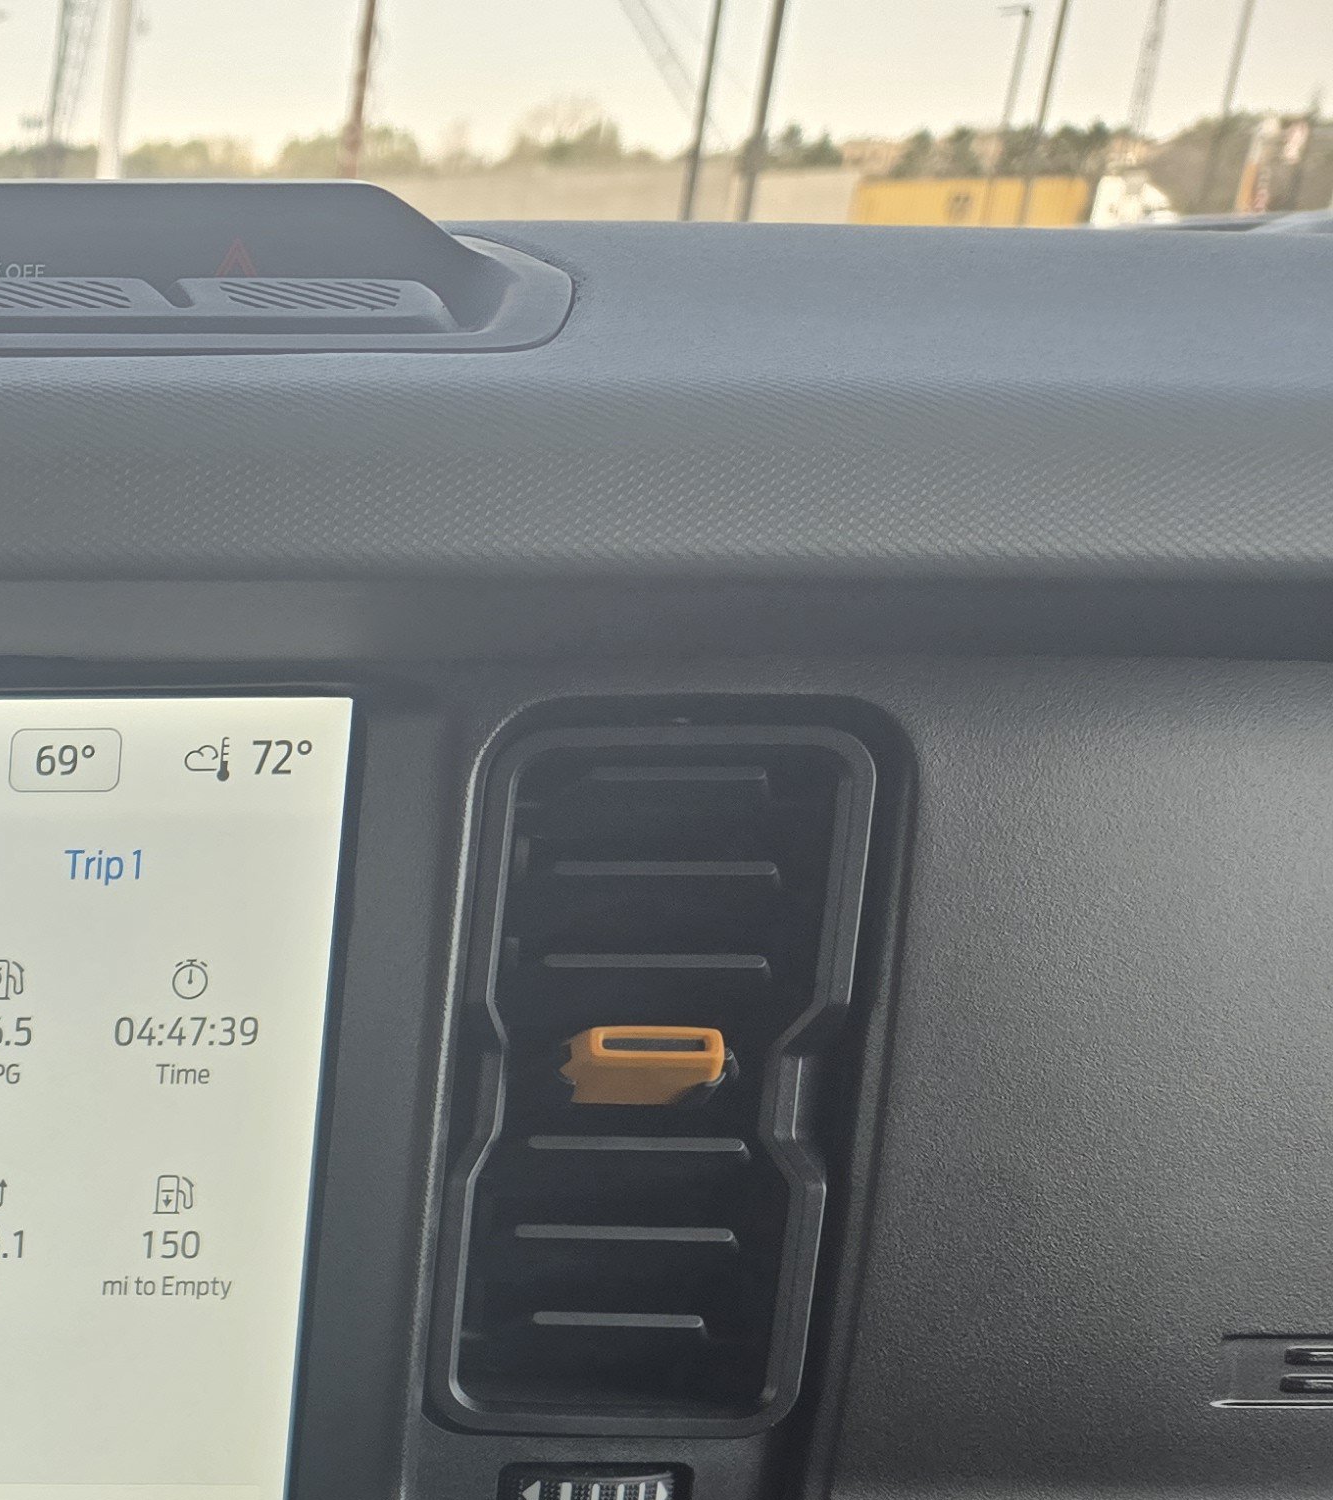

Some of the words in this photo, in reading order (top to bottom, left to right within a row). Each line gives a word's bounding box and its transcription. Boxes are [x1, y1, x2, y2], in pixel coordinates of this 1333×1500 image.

[36, 745, 95, 775] 69°
[253, 740, 312, 774] 72°
[65, 850, 123, 886] Trip
[133, 850, 141, 879] 1
[115, 1017, 258, 1046] 04:47:39
[156, 1064, 210, 1084] Time
[143, 1231, 200, 1259] 150
[102, 1276, 128, 1295] mi
[135, 1277, 155, 1295] to
[162, 1276, 232, 1299] Empty
